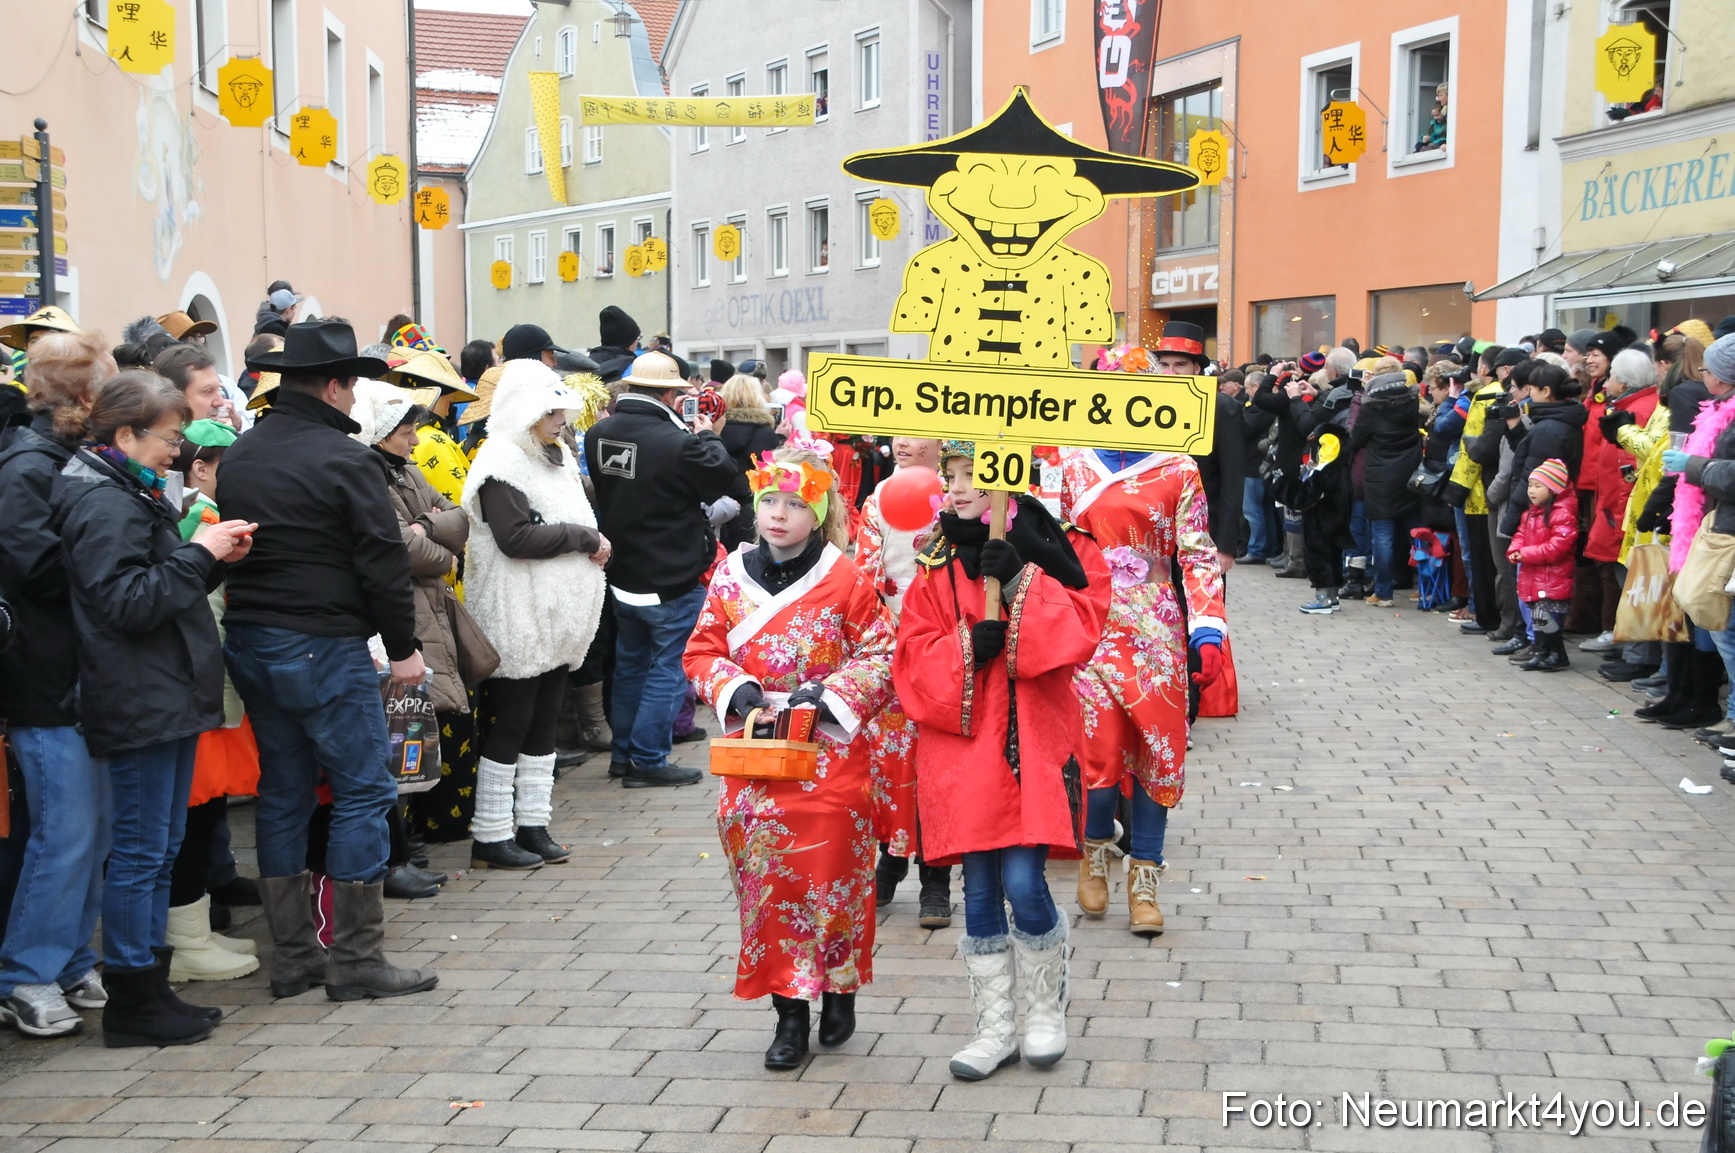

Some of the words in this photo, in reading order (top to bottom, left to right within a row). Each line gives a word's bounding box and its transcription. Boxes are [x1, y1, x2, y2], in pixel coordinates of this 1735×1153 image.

[118, 45, 135, 63] 人
[1328, 136, 1343, 155] 人
[1151, 265, 1219, 296] GÖTZ
[728, 292, 776, 328] OPTIK
[779, 286, 829, 325] OEXL
[829, 376, 902, 417] Grp.
[915, 382, 1077, 427] Stampfer
[1087, 392, 1113, 425] &
[1125, 396, 1191, 429] Co.
[977, 450, 1025, 486] 30
